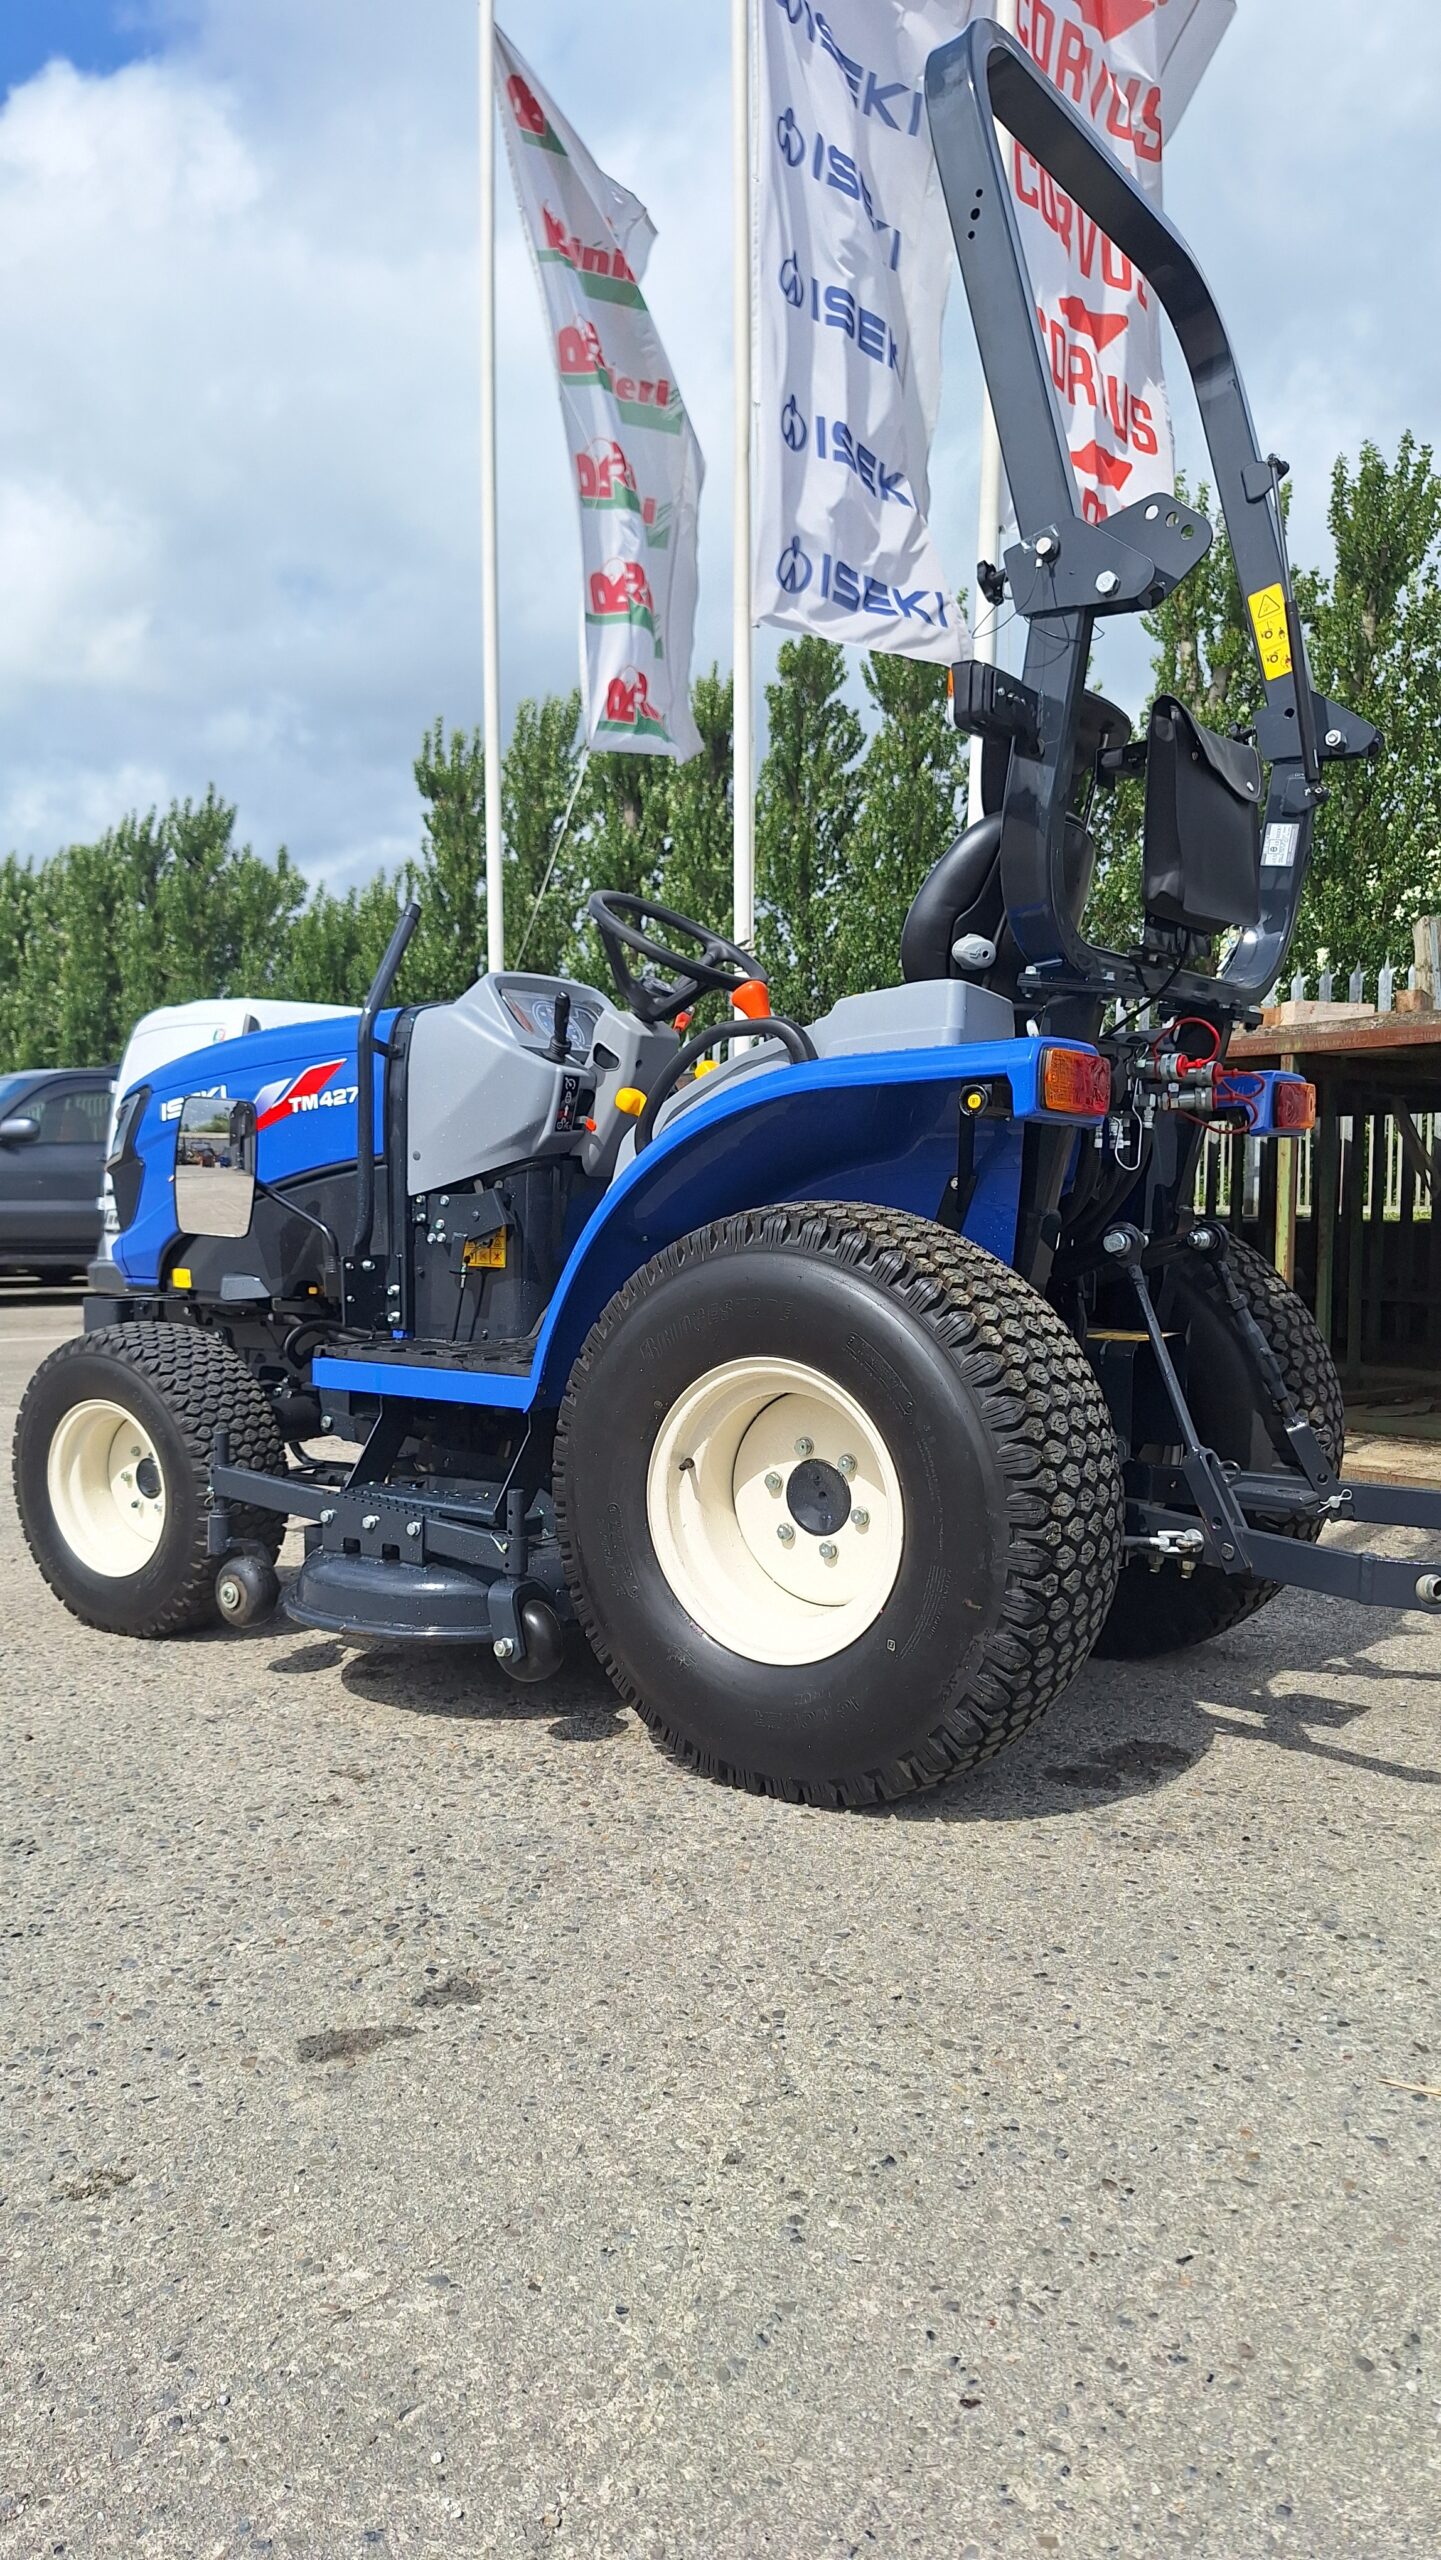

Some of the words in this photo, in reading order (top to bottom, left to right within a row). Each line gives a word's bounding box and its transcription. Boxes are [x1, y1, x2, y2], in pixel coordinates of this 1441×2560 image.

[804, 0, 922, 136] ISEKI
[812, 132, 900, 271] ISI
[811, 277, 899, 371] ISE
[1037, 306, 1158, 456] ORUS
[816, 415, 914, 509] ISEK
[820, 553, 949, 628] ISEKI
[161, 1085, 227, 1121] ISI
[288, 1086, 358, 1113] TM427
